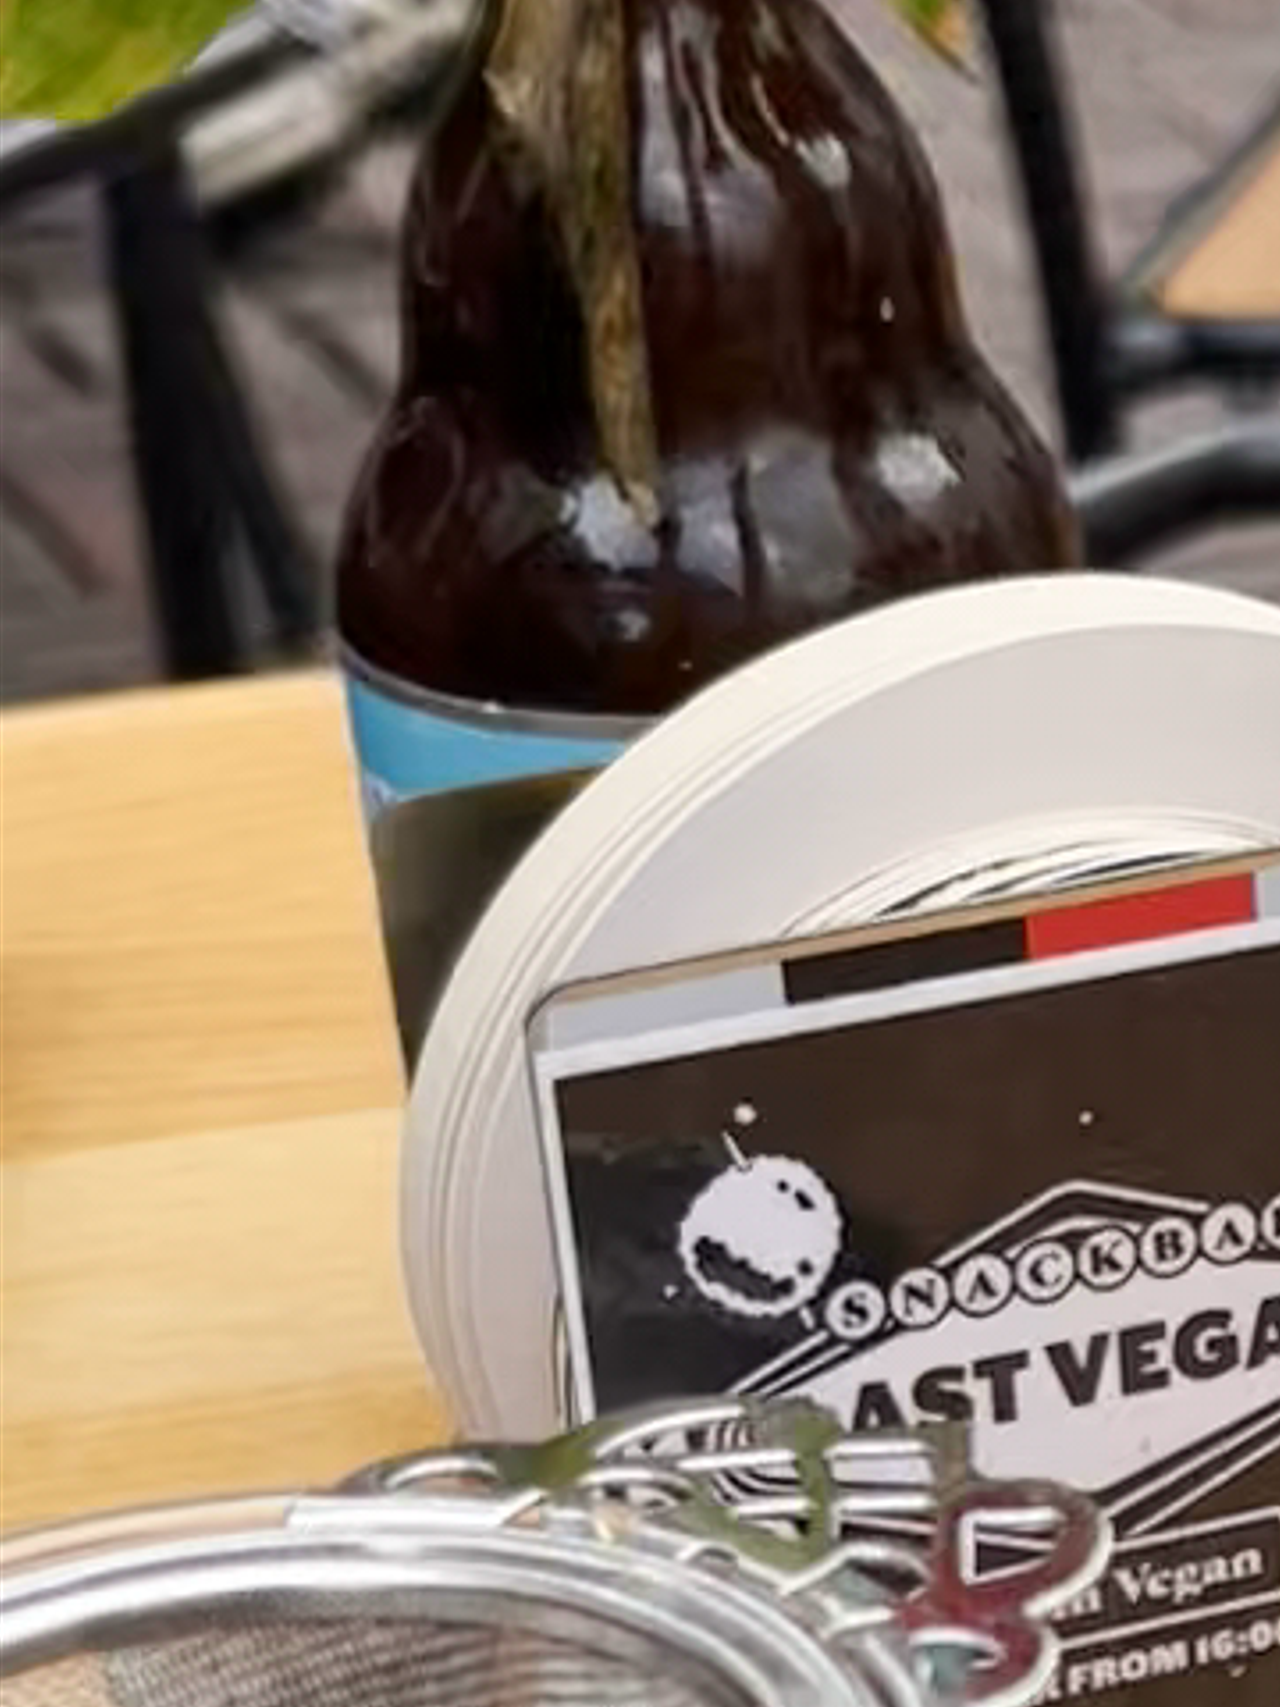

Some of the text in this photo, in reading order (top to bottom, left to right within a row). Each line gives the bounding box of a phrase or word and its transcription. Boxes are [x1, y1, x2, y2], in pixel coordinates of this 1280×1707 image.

[850, 1350, 1030, 1431] AST
[1113, 1548, 1263, 1604] Vegan
[1066, 1641, 1189, 1695] FROM
